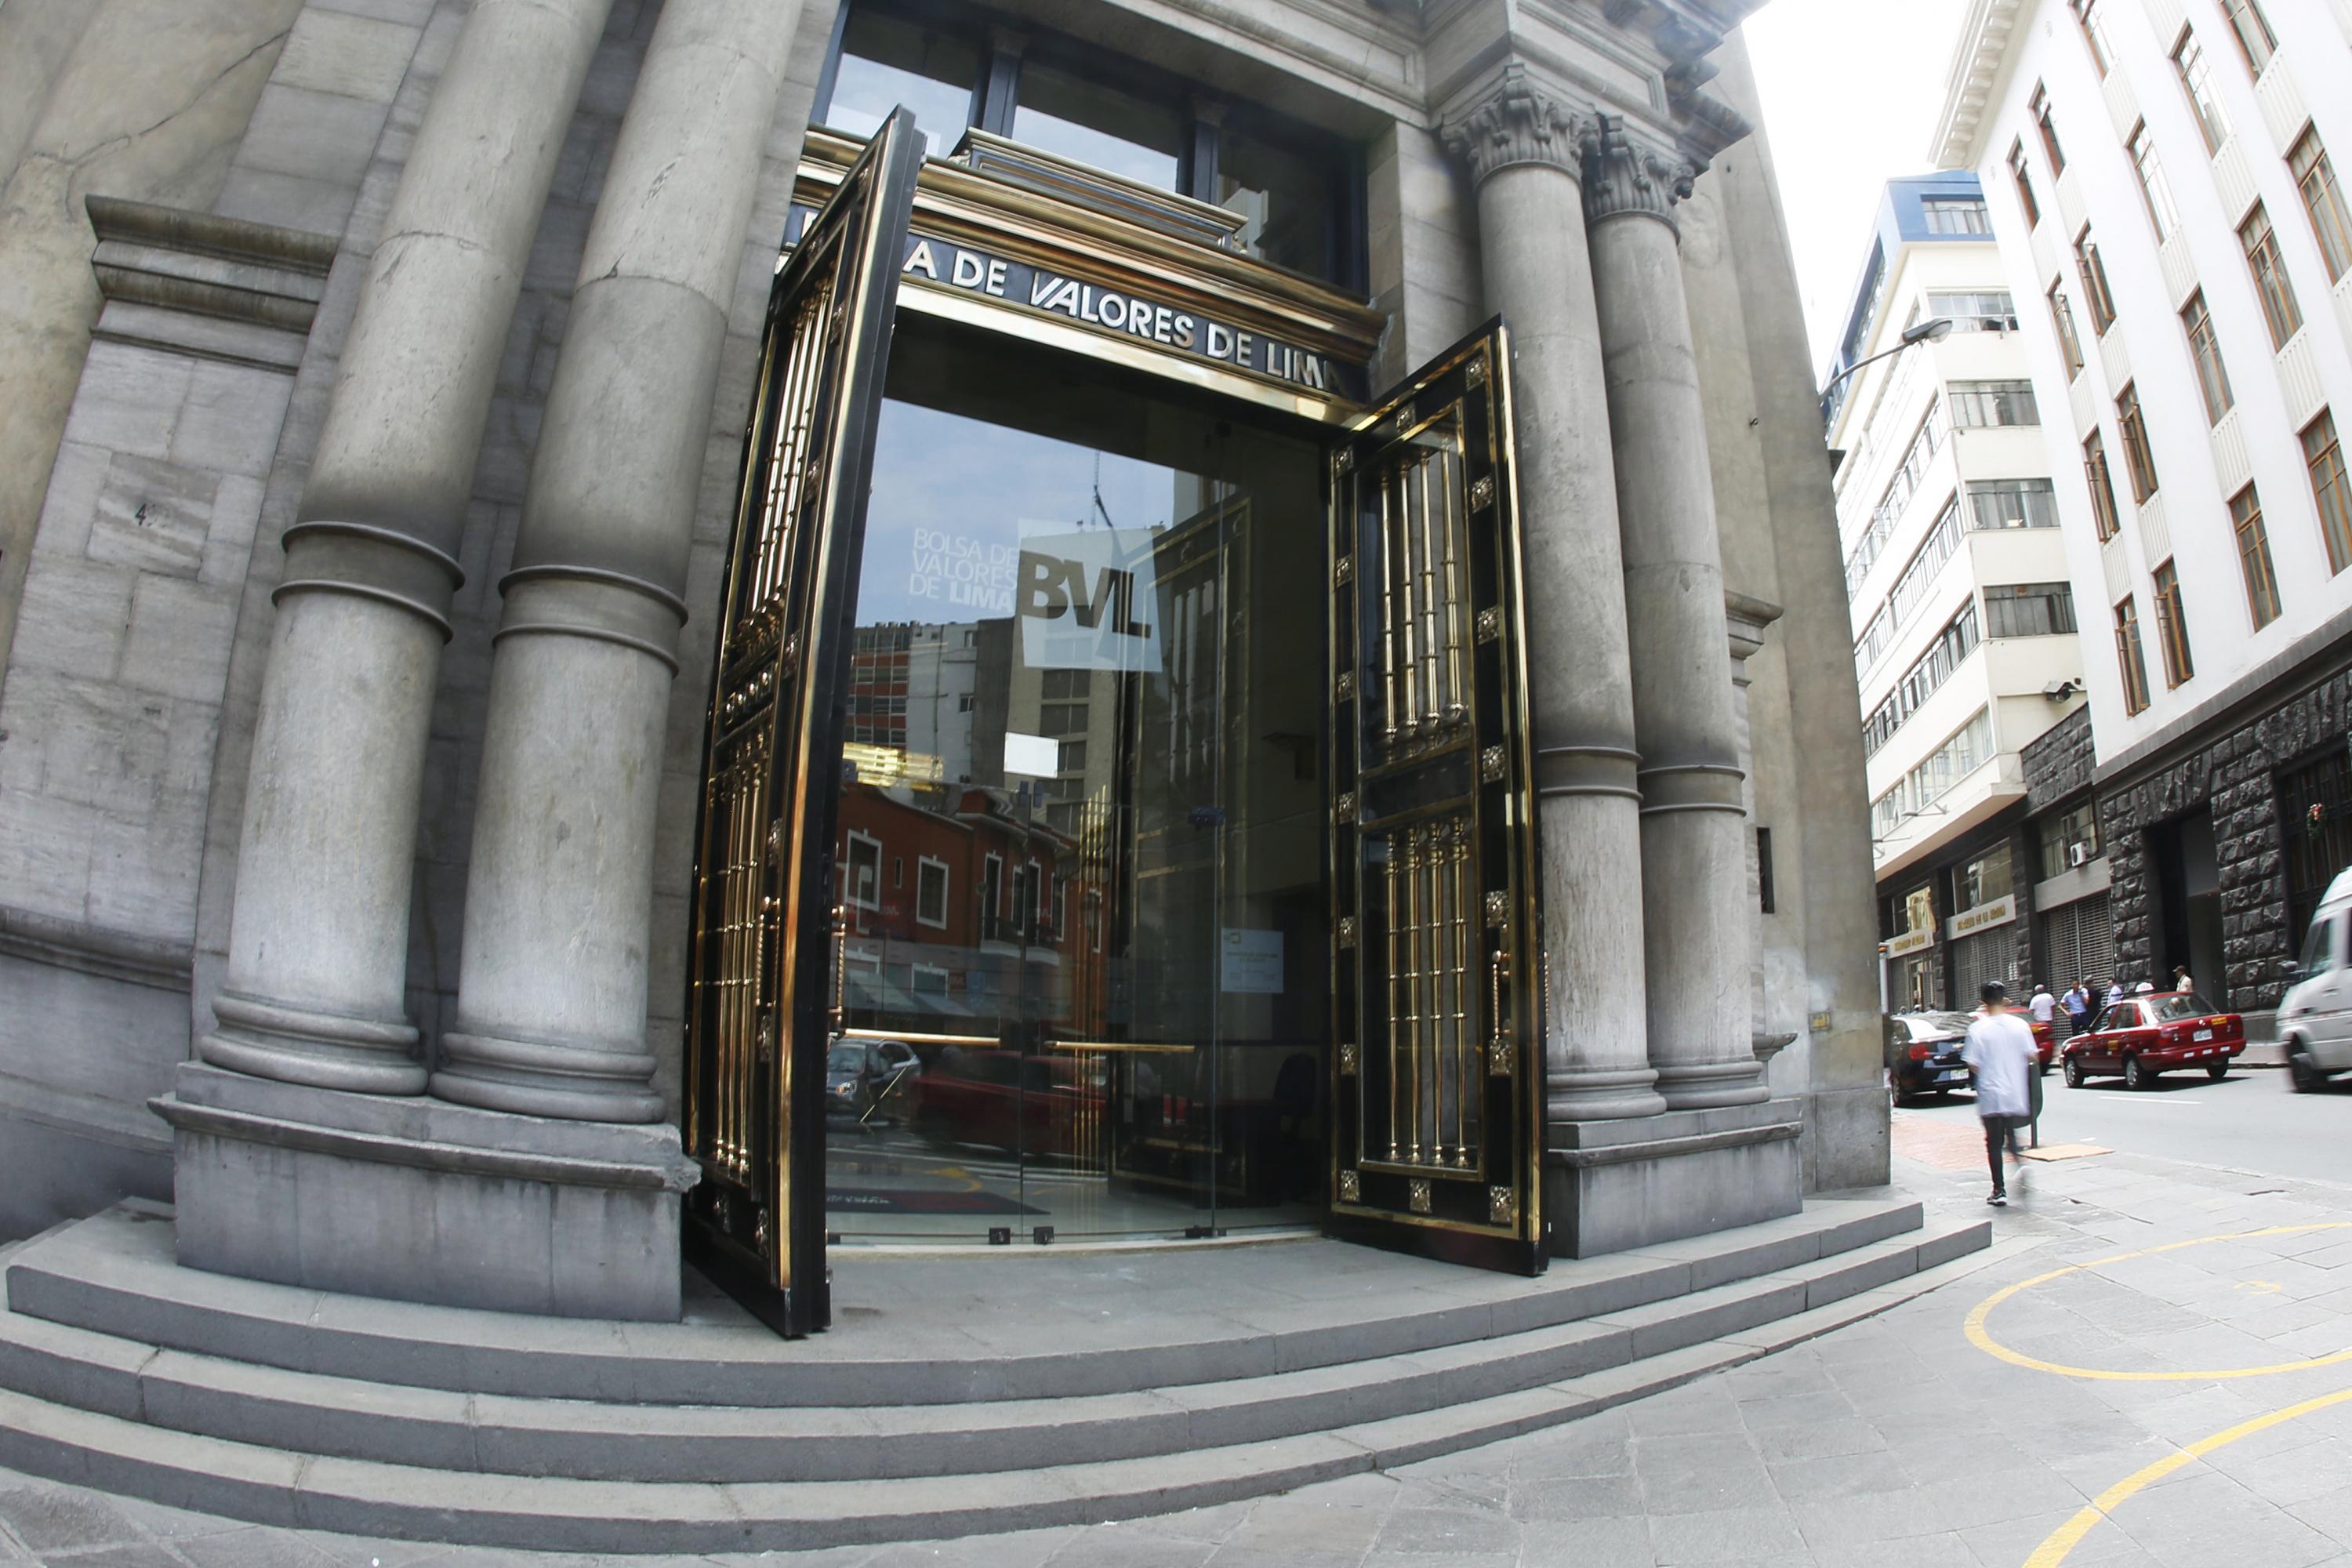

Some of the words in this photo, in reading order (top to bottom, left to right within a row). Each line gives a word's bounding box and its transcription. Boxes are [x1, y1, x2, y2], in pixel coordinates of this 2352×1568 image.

[951, 249, 1007, 297] DE
[1029, 271, 1195, 348] VALORES
[1207, 322, 1254, 368] DE
[1265, 342, 1346, 396] LIMA
[913, 527, 983, 561] BOLSA
[989, 543, 1020, 568] DE
[912, 549, 1019, 590] VALORES
[909, 572, 941, 600] DE
[949, 580, 1014, 614] LIMA
[1018, 549, 1152, 639] BVL
